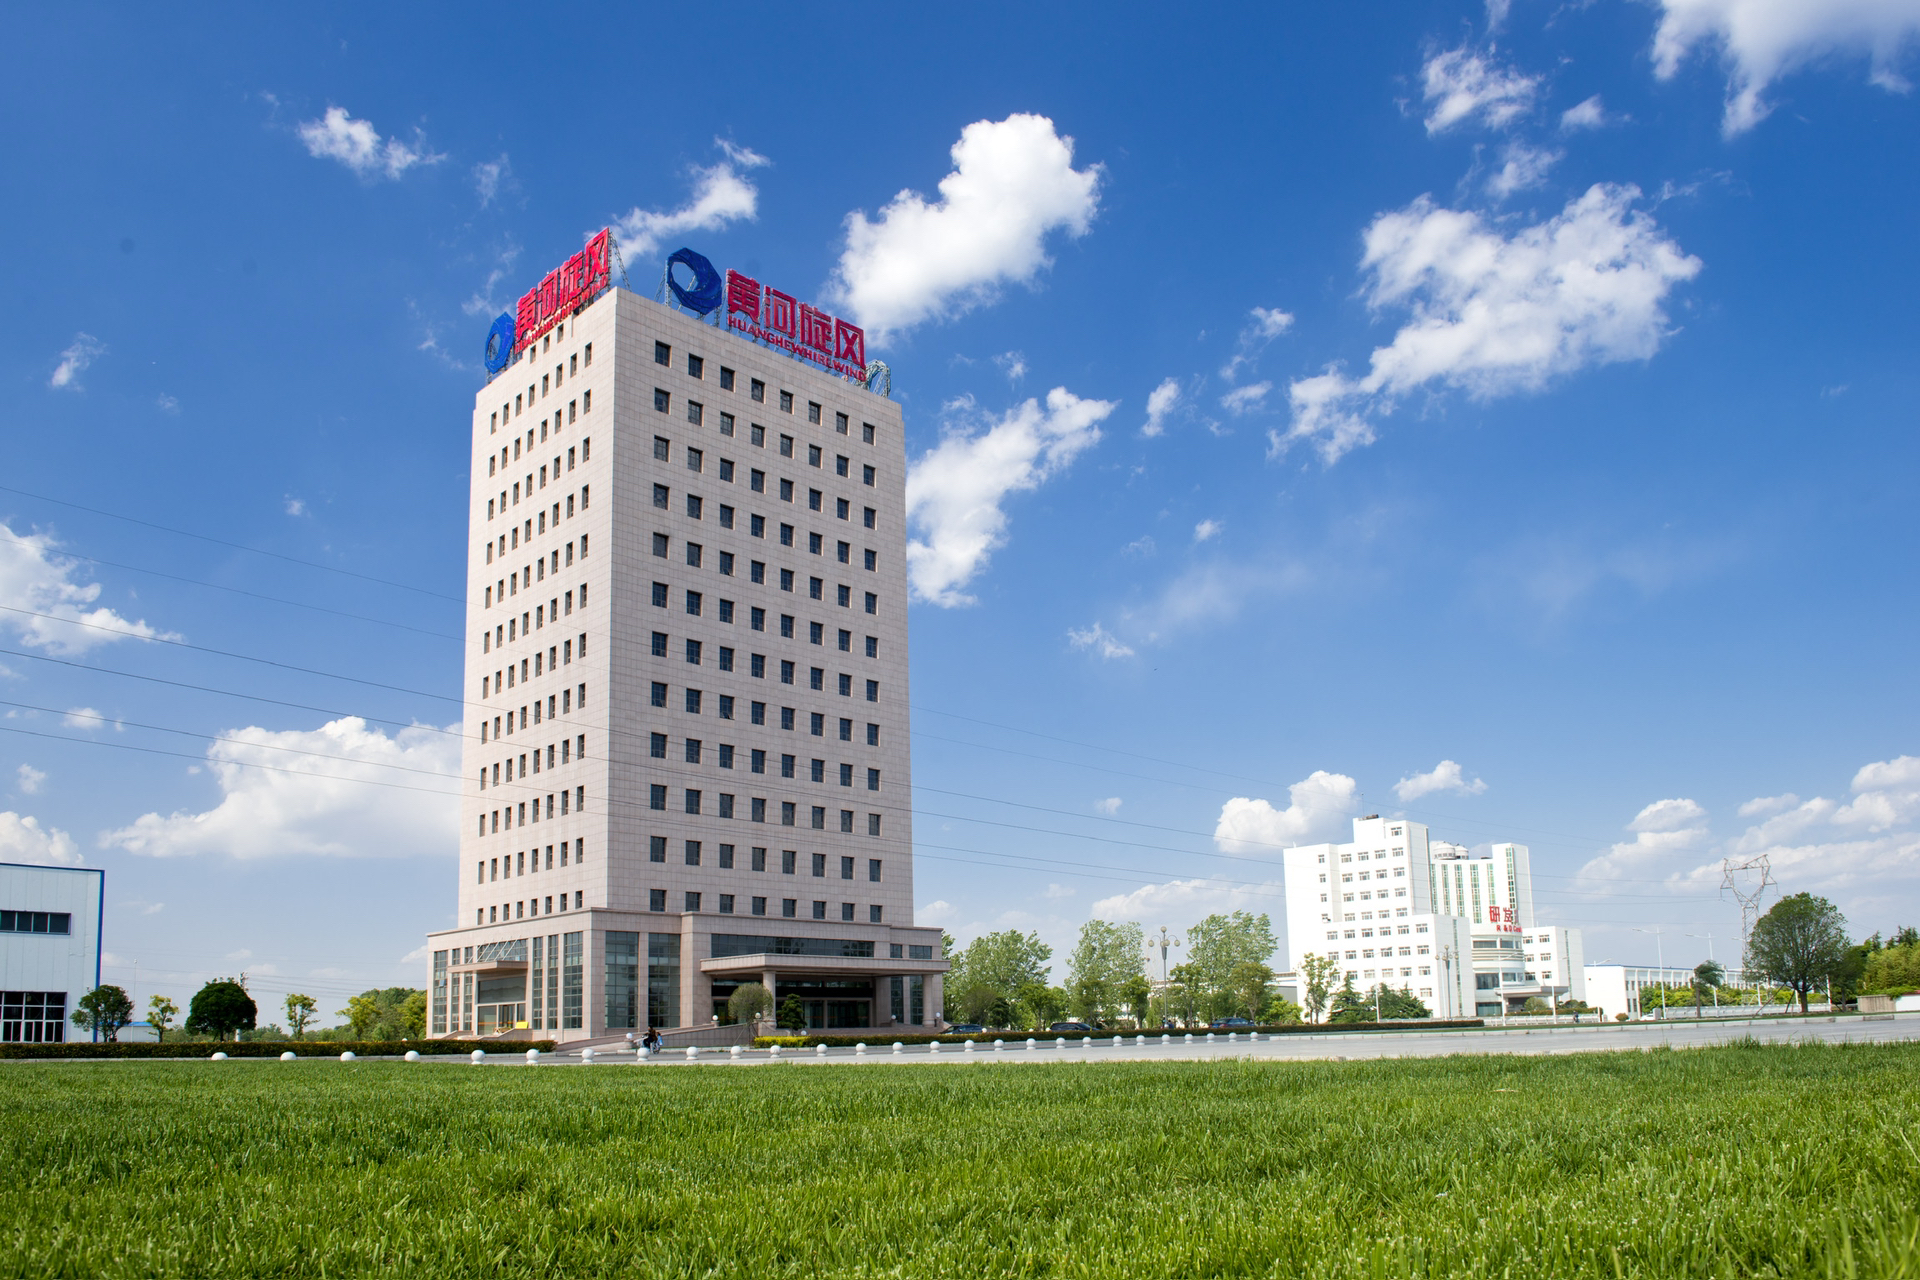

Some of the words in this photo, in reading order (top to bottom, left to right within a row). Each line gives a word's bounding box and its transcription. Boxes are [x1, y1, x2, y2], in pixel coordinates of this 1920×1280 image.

[515, 227, 609, 341] 黄河旋风
[726, 268, 866, 370] 黄河旋风
